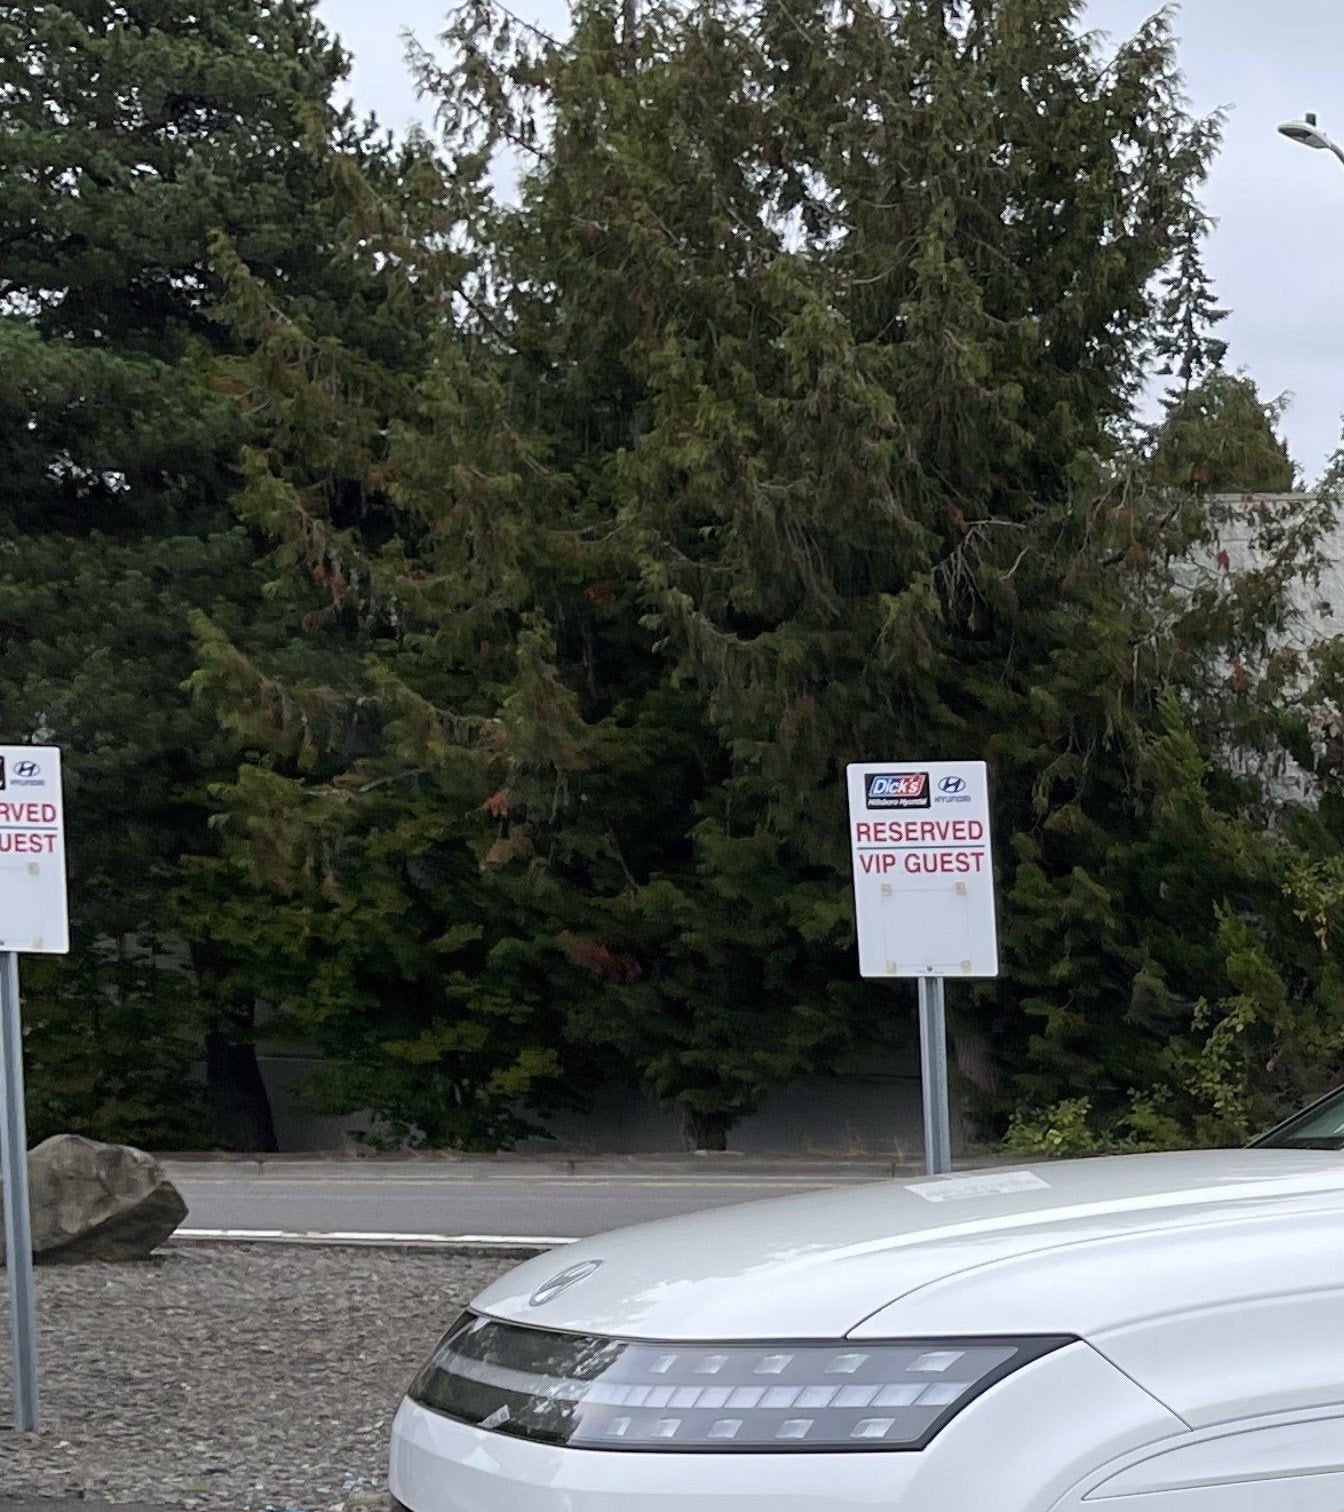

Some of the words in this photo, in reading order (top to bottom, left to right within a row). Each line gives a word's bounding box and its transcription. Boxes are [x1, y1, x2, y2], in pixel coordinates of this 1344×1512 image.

[872, 776, 920, 794] Dick's
[856, 820, 984, 842] RESERVED
[859, 853, 896, 874] VIP
[904, 852, 985, 873] GUEST
